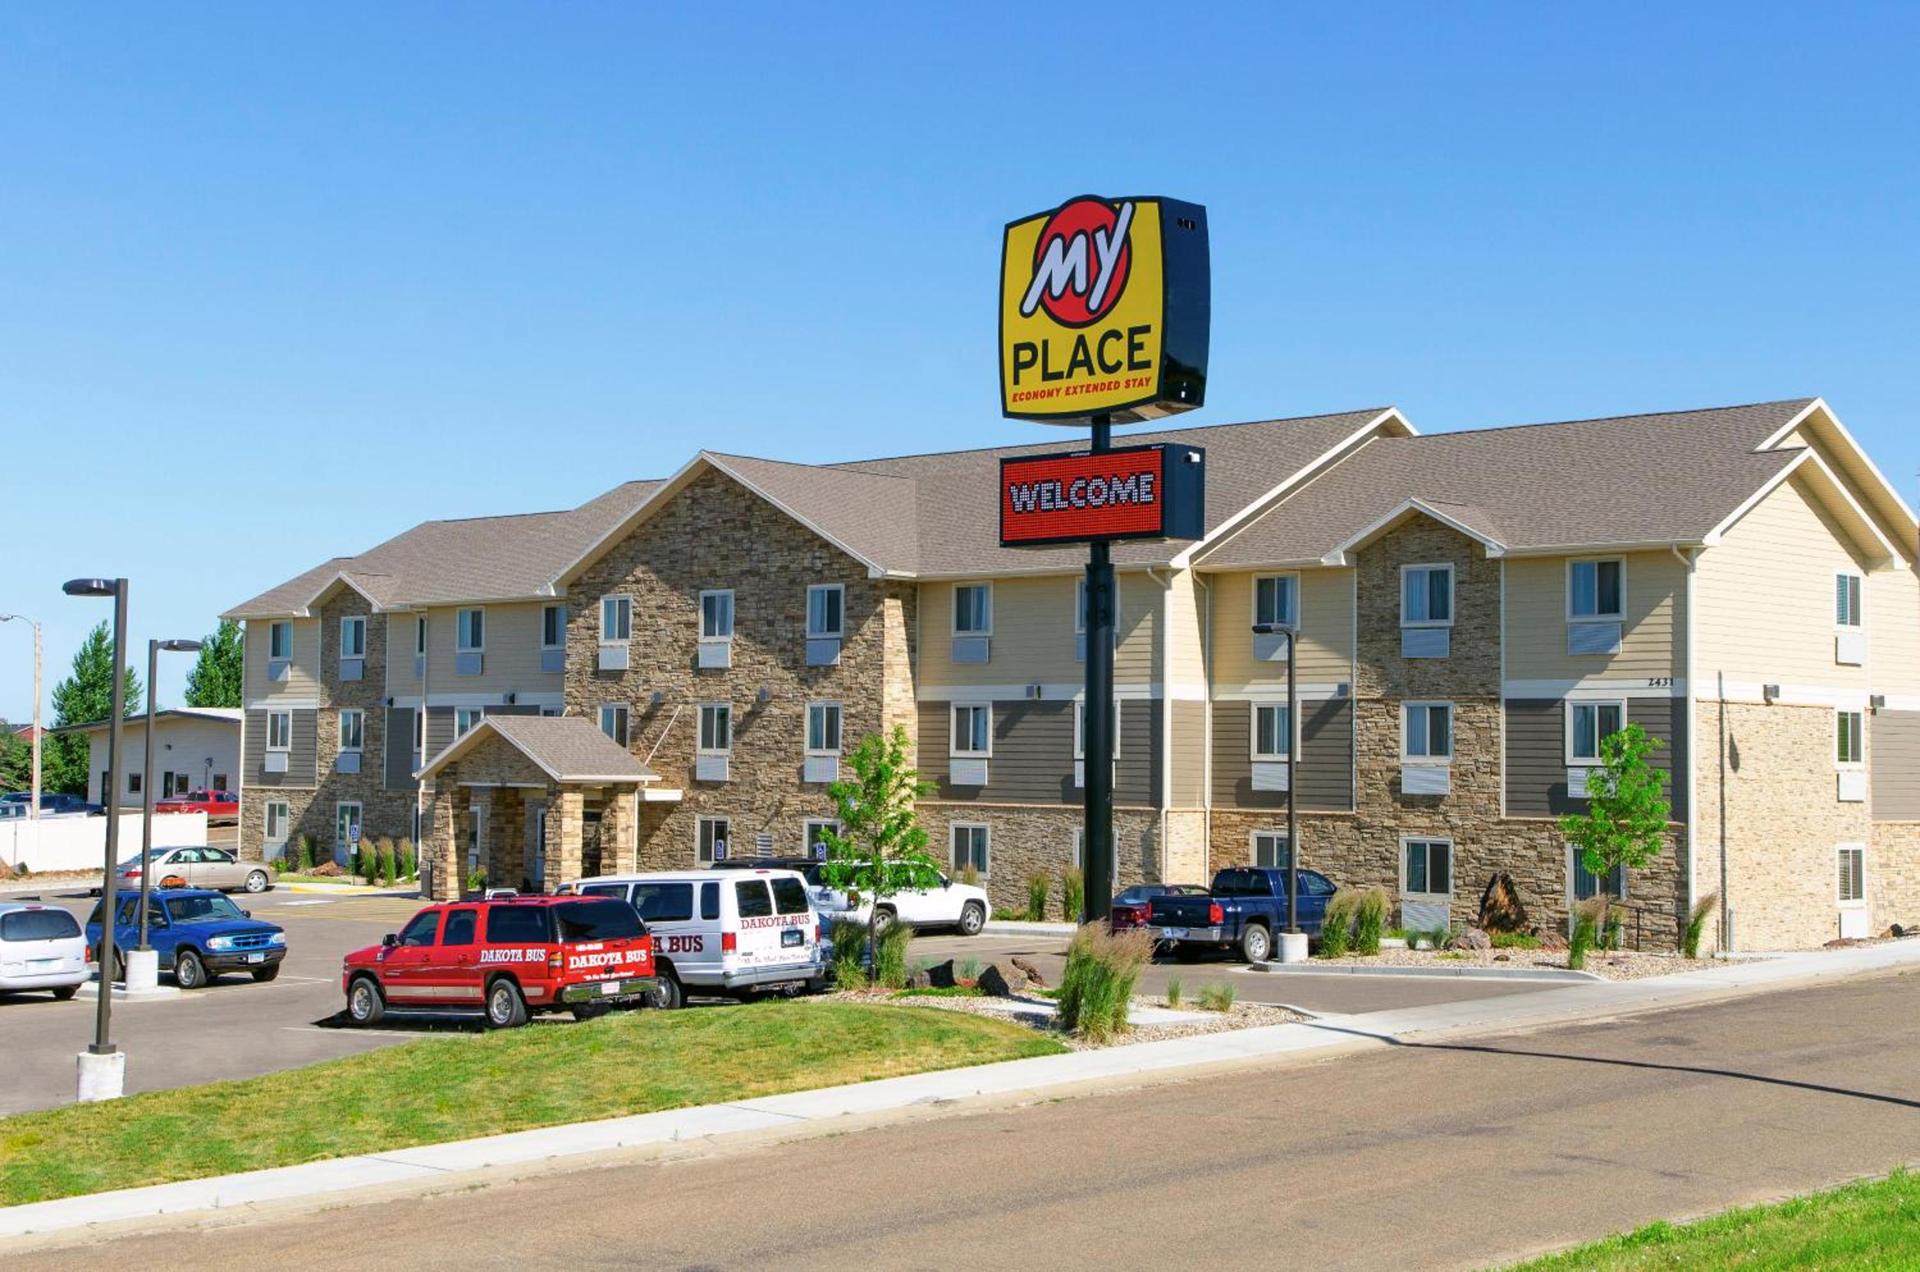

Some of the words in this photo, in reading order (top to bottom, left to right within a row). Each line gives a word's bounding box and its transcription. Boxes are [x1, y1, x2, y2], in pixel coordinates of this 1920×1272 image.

[1012, 324, 1152, 386] PLACE
[1012, 387, 1062, 403] ECONOMY
[1064, 380, 1121, 396] EXTENDED
[1124, 376, 1152, 389] STAY
[1010, 473, 1154, 512] WELCOME
[1648, 677, 1674, 687] 2431
[741, 916, 788, 930] DAKOTA
[790, 914, 811, 926] BUS
[667, 934, 704, 953] BUS
[480, 949, 523, 963] DAKOTA
[525, 948, 546, 962] BUS
[568, 951, 624, 970] DAKOTA
[625, 949, 647, 964] BUS
